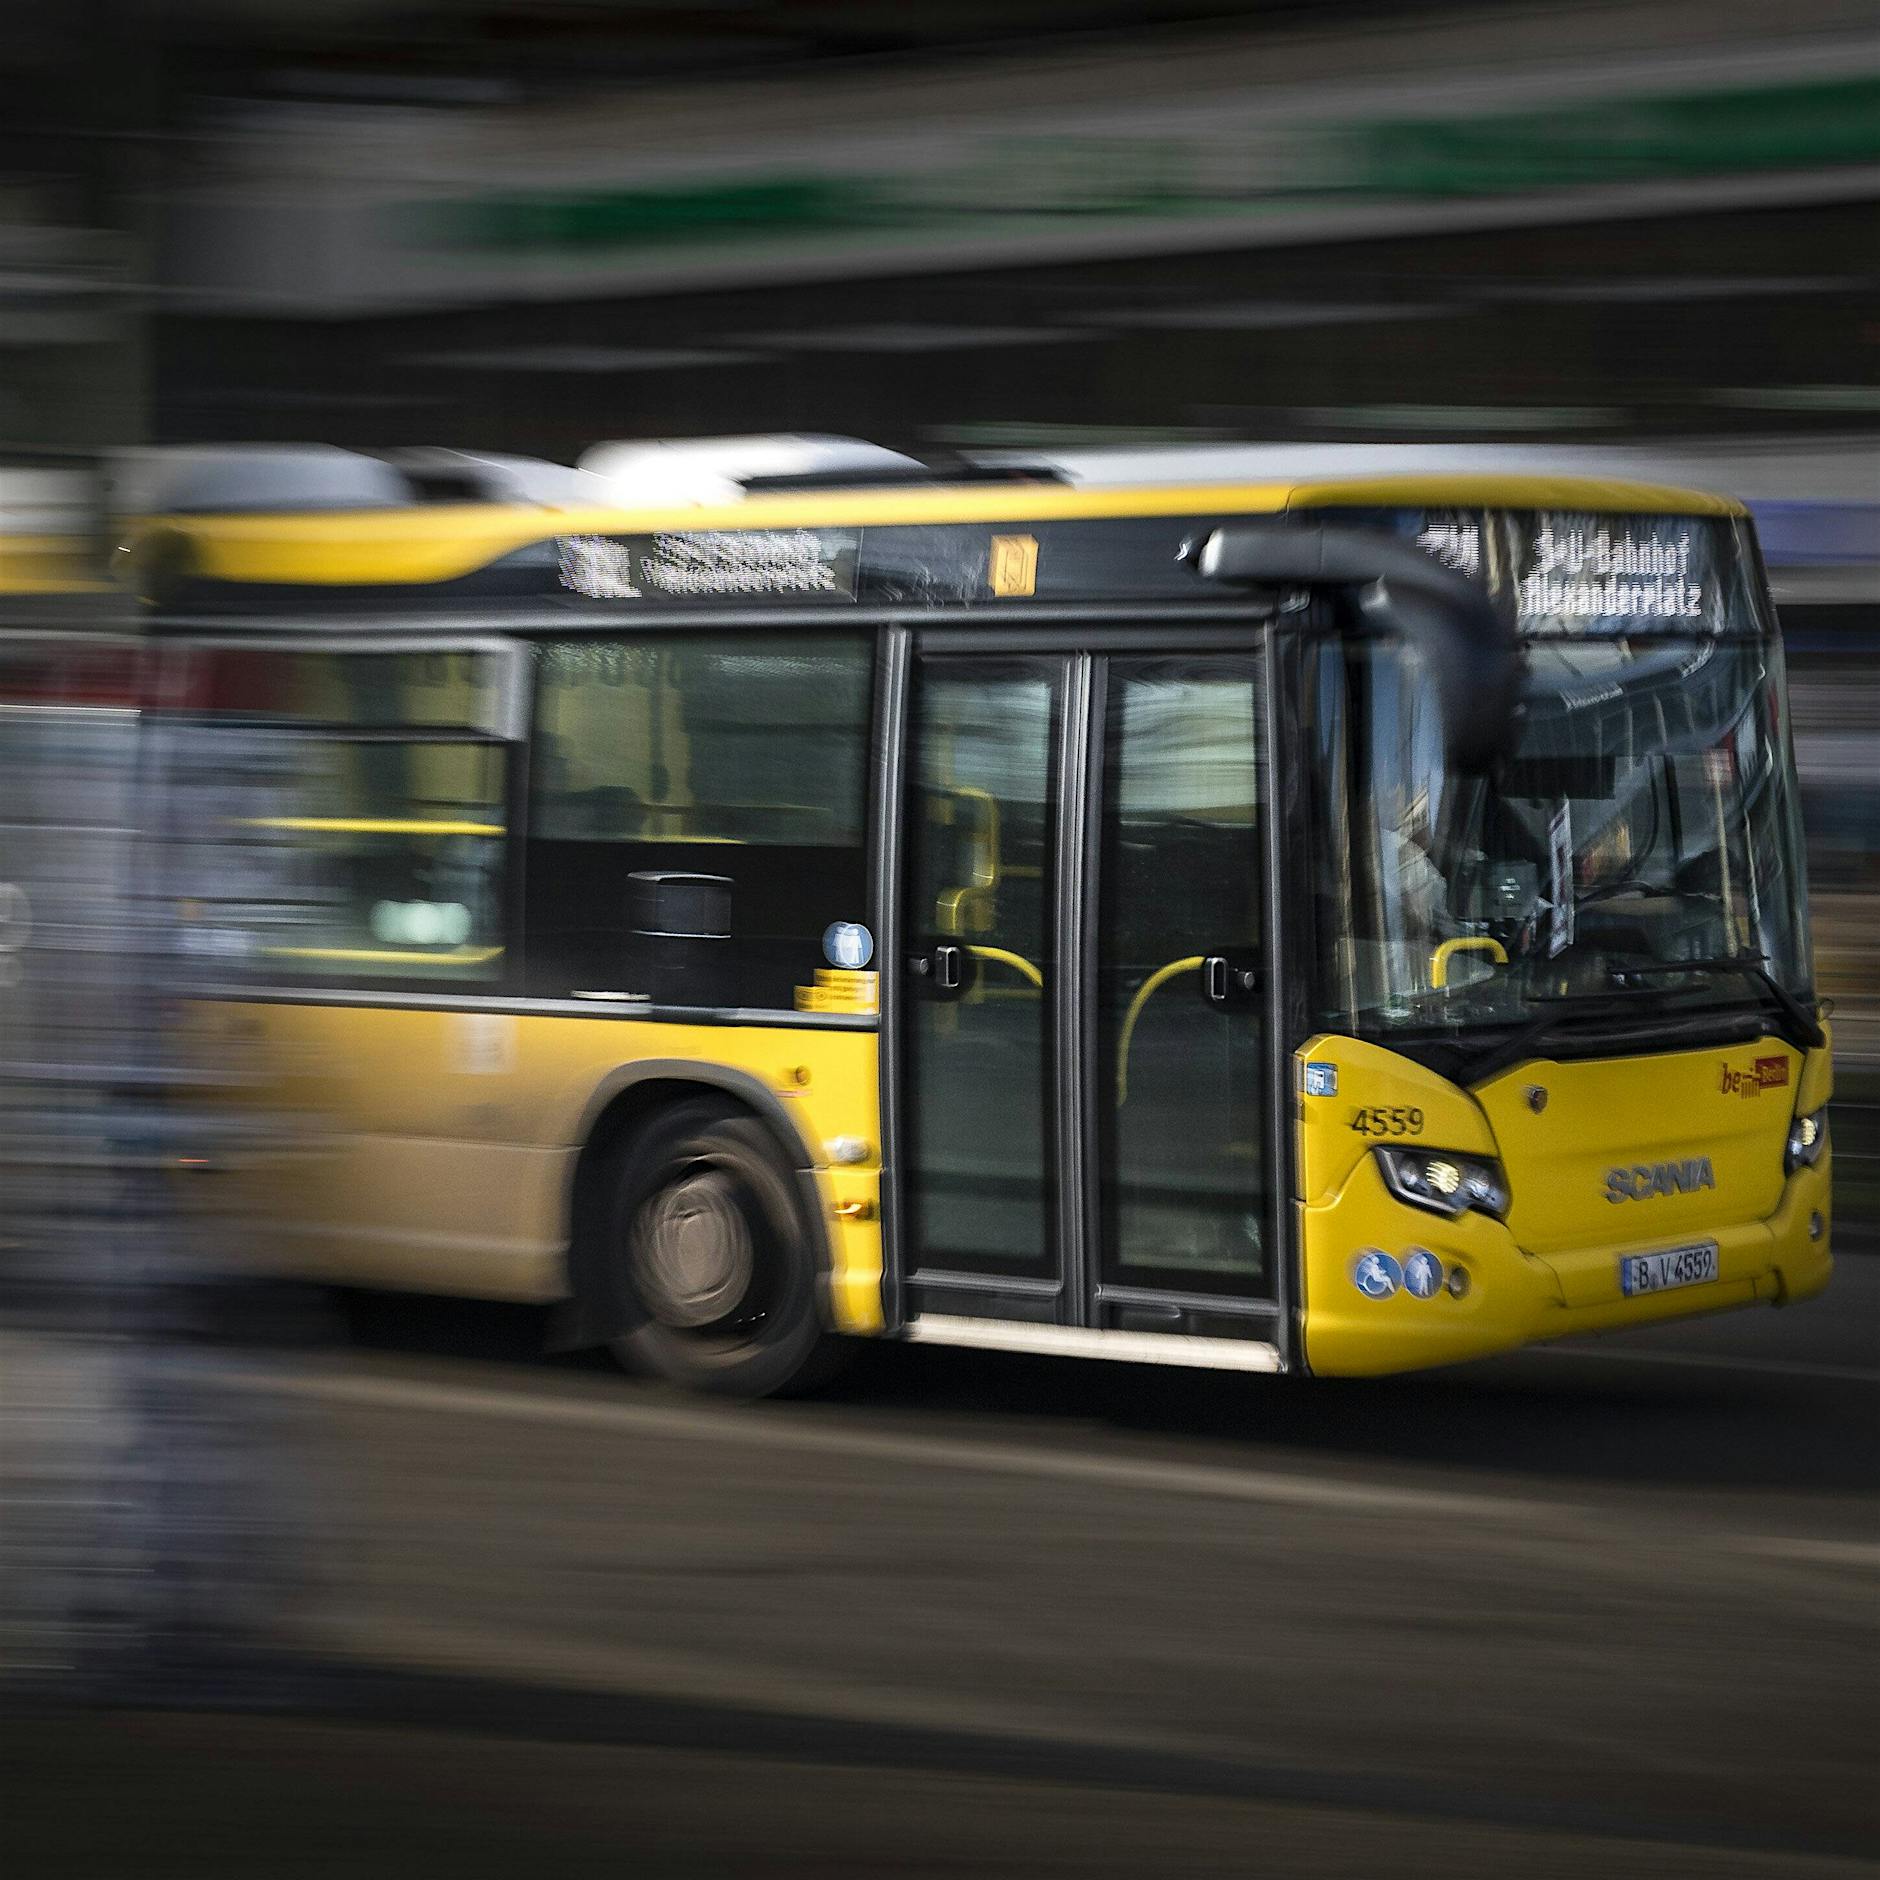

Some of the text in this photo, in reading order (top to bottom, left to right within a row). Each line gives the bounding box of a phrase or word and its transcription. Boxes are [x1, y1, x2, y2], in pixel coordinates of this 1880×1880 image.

[1350, 1106, 1425, 1136] 4559
[1605, 1157, 1716, 1204] SCANIA
[1674, 1251, 1712, 1282] 4559
